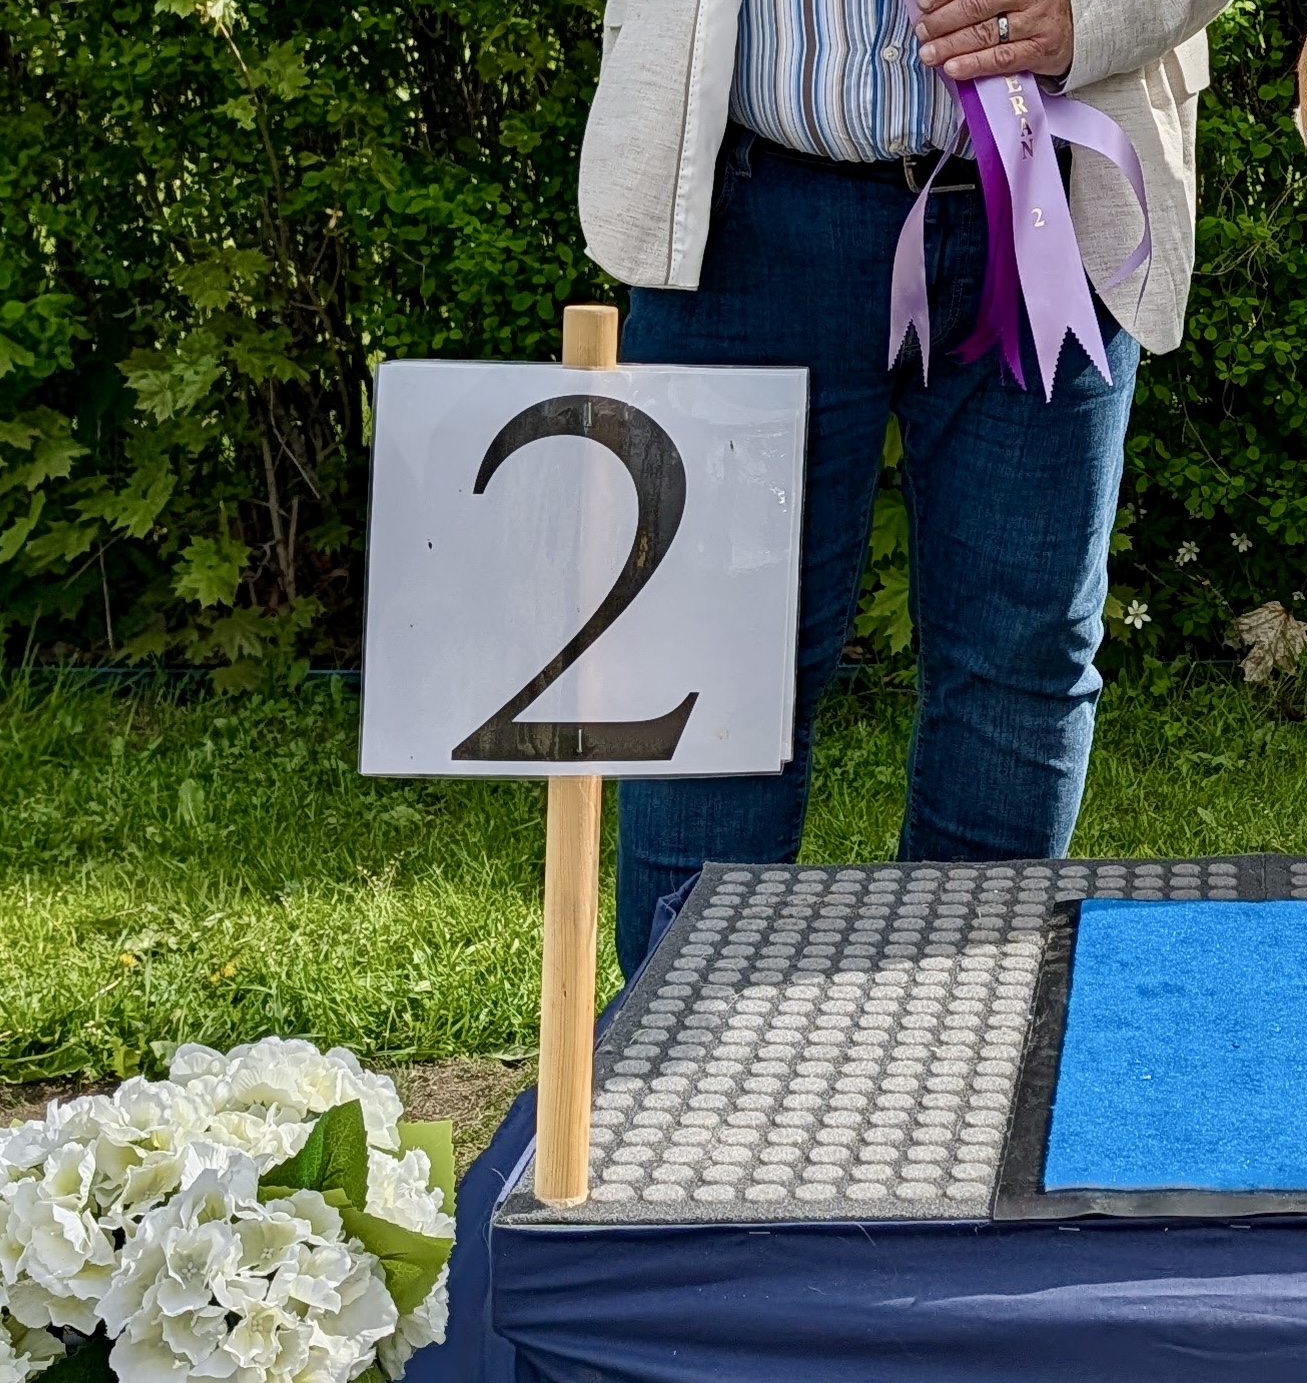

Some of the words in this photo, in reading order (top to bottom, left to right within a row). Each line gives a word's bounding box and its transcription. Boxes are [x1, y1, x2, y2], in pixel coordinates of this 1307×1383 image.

[1004, 75, 1034, 160] ERAN
[1031, 208, 1045, 227] 2
[451, 394, 700, 761] 2
